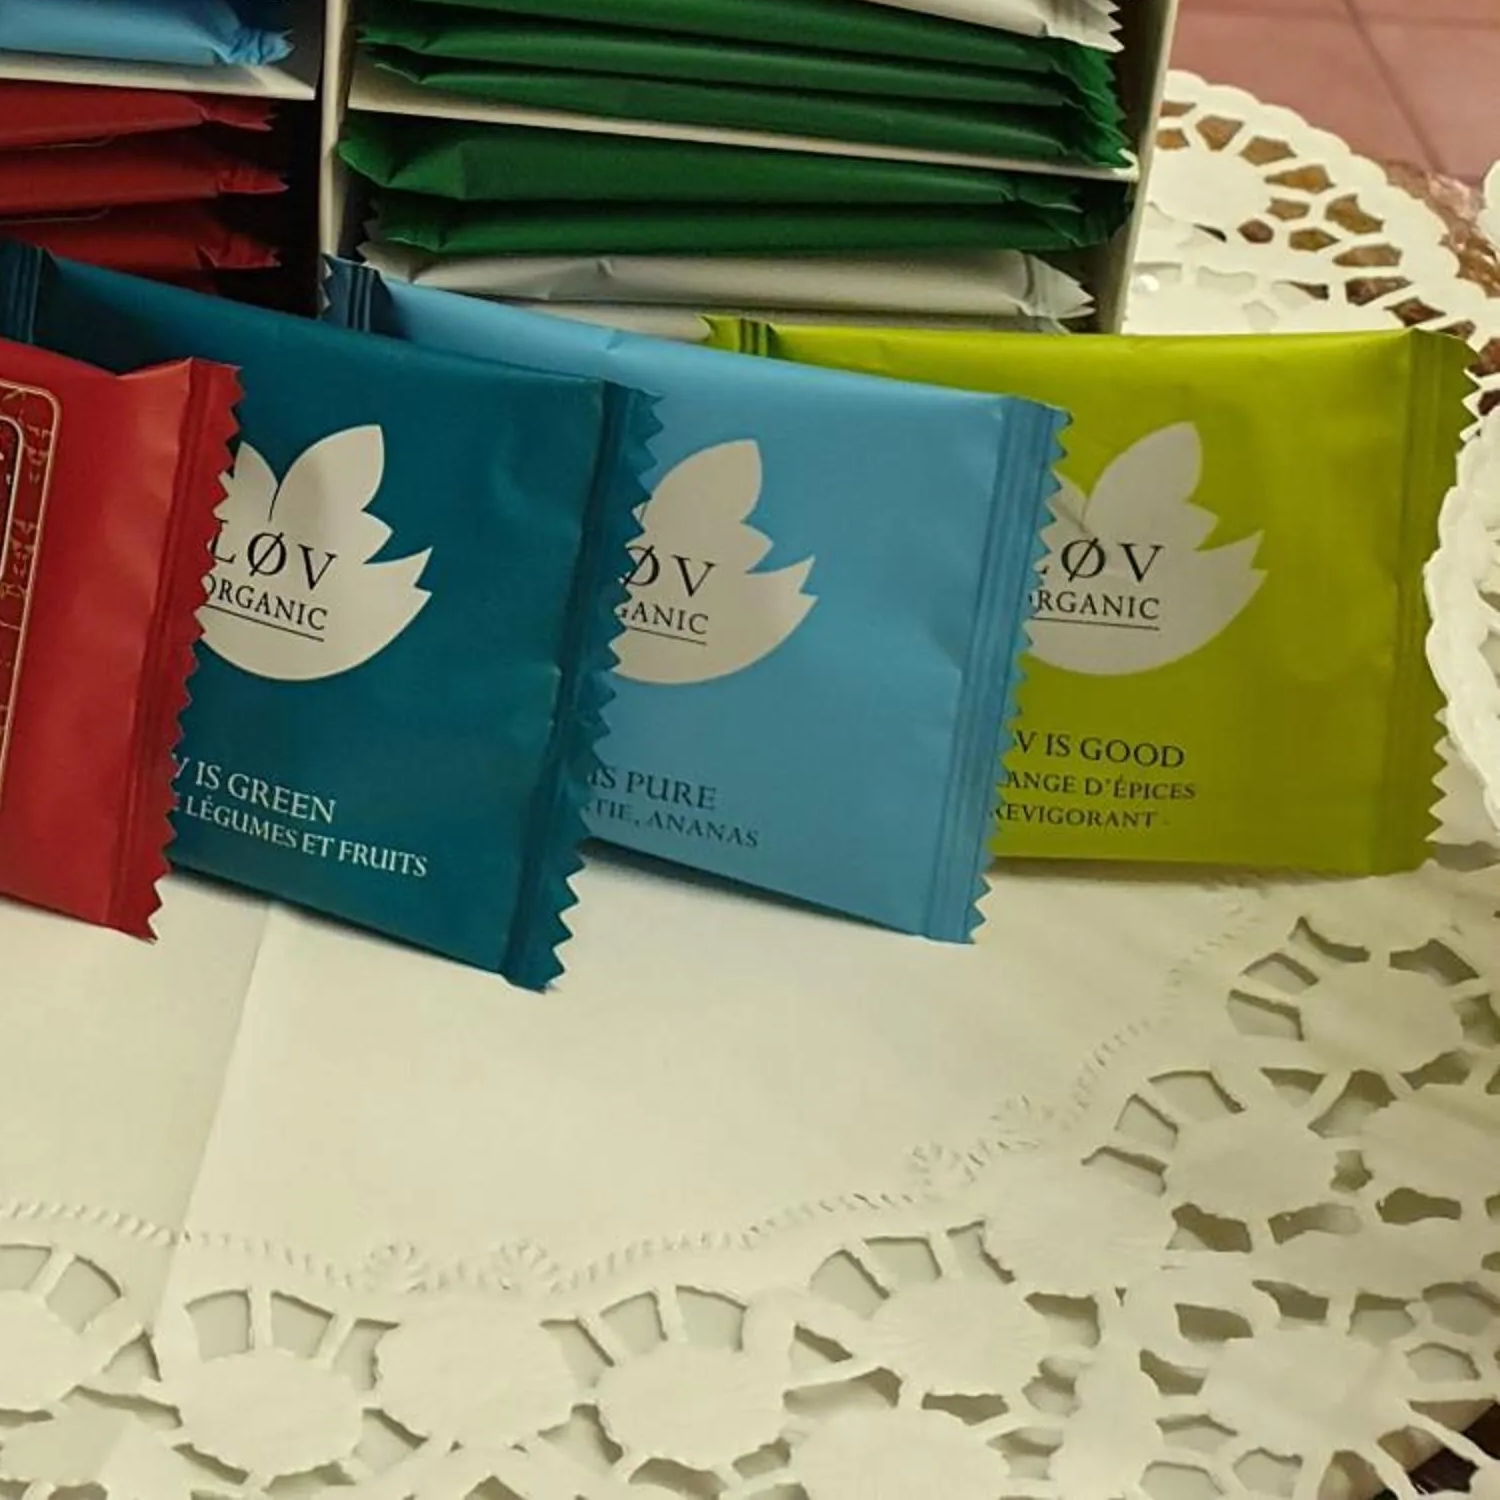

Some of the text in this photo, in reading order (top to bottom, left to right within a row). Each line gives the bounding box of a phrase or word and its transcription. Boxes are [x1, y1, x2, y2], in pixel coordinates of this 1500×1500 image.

[623, 544, 717, 598] ØV
[1037, 537, 1165, 583] ØV
[620, 600, 709, 635] ANIC
[1028, 589, 1161, 620] RGANIC
[1044, 731, 1071, 758] IS
[1079, 736, 1185, 768] GOOD
[195, 760, 222, 790] IS
[227, 772, 337, 825] GREEN
[626, 770, 718, 811] PURE
[998, 771, 1196, 800] ANGE D'ÉPICES
[186, 794, 299, 849] LÉGUMES
[301, 832, 335, 859] ET
[338, 839, 429, 878] FRUITS
[645, 810, 760, 848] ANANAS
